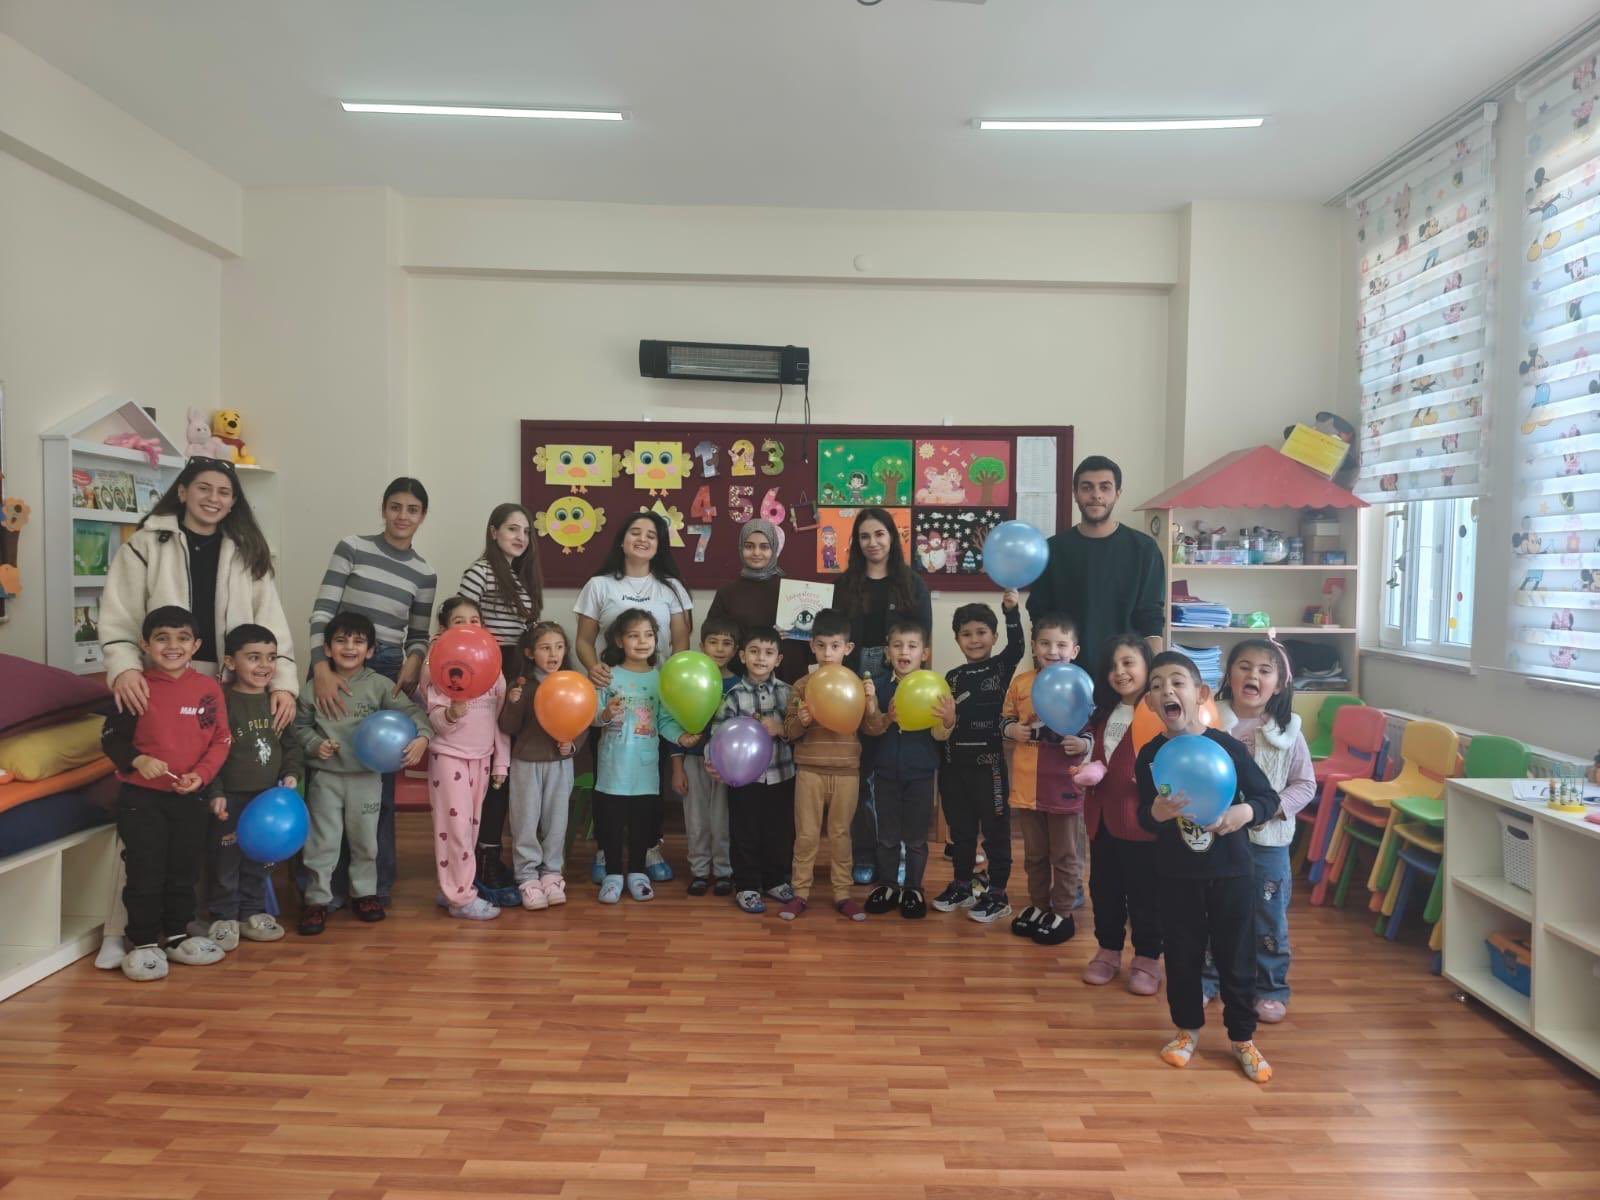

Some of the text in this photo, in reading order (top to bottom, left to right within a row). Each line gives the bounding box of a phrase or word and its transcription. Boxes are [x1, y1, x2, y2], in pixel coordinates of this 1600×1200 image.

[694, 439, 785, 478] 1 2 3
[690, 485, 786, 526] 4 5 6
[687, 524, 712, 562] 7
[248, 718, 269, 731] POLO
